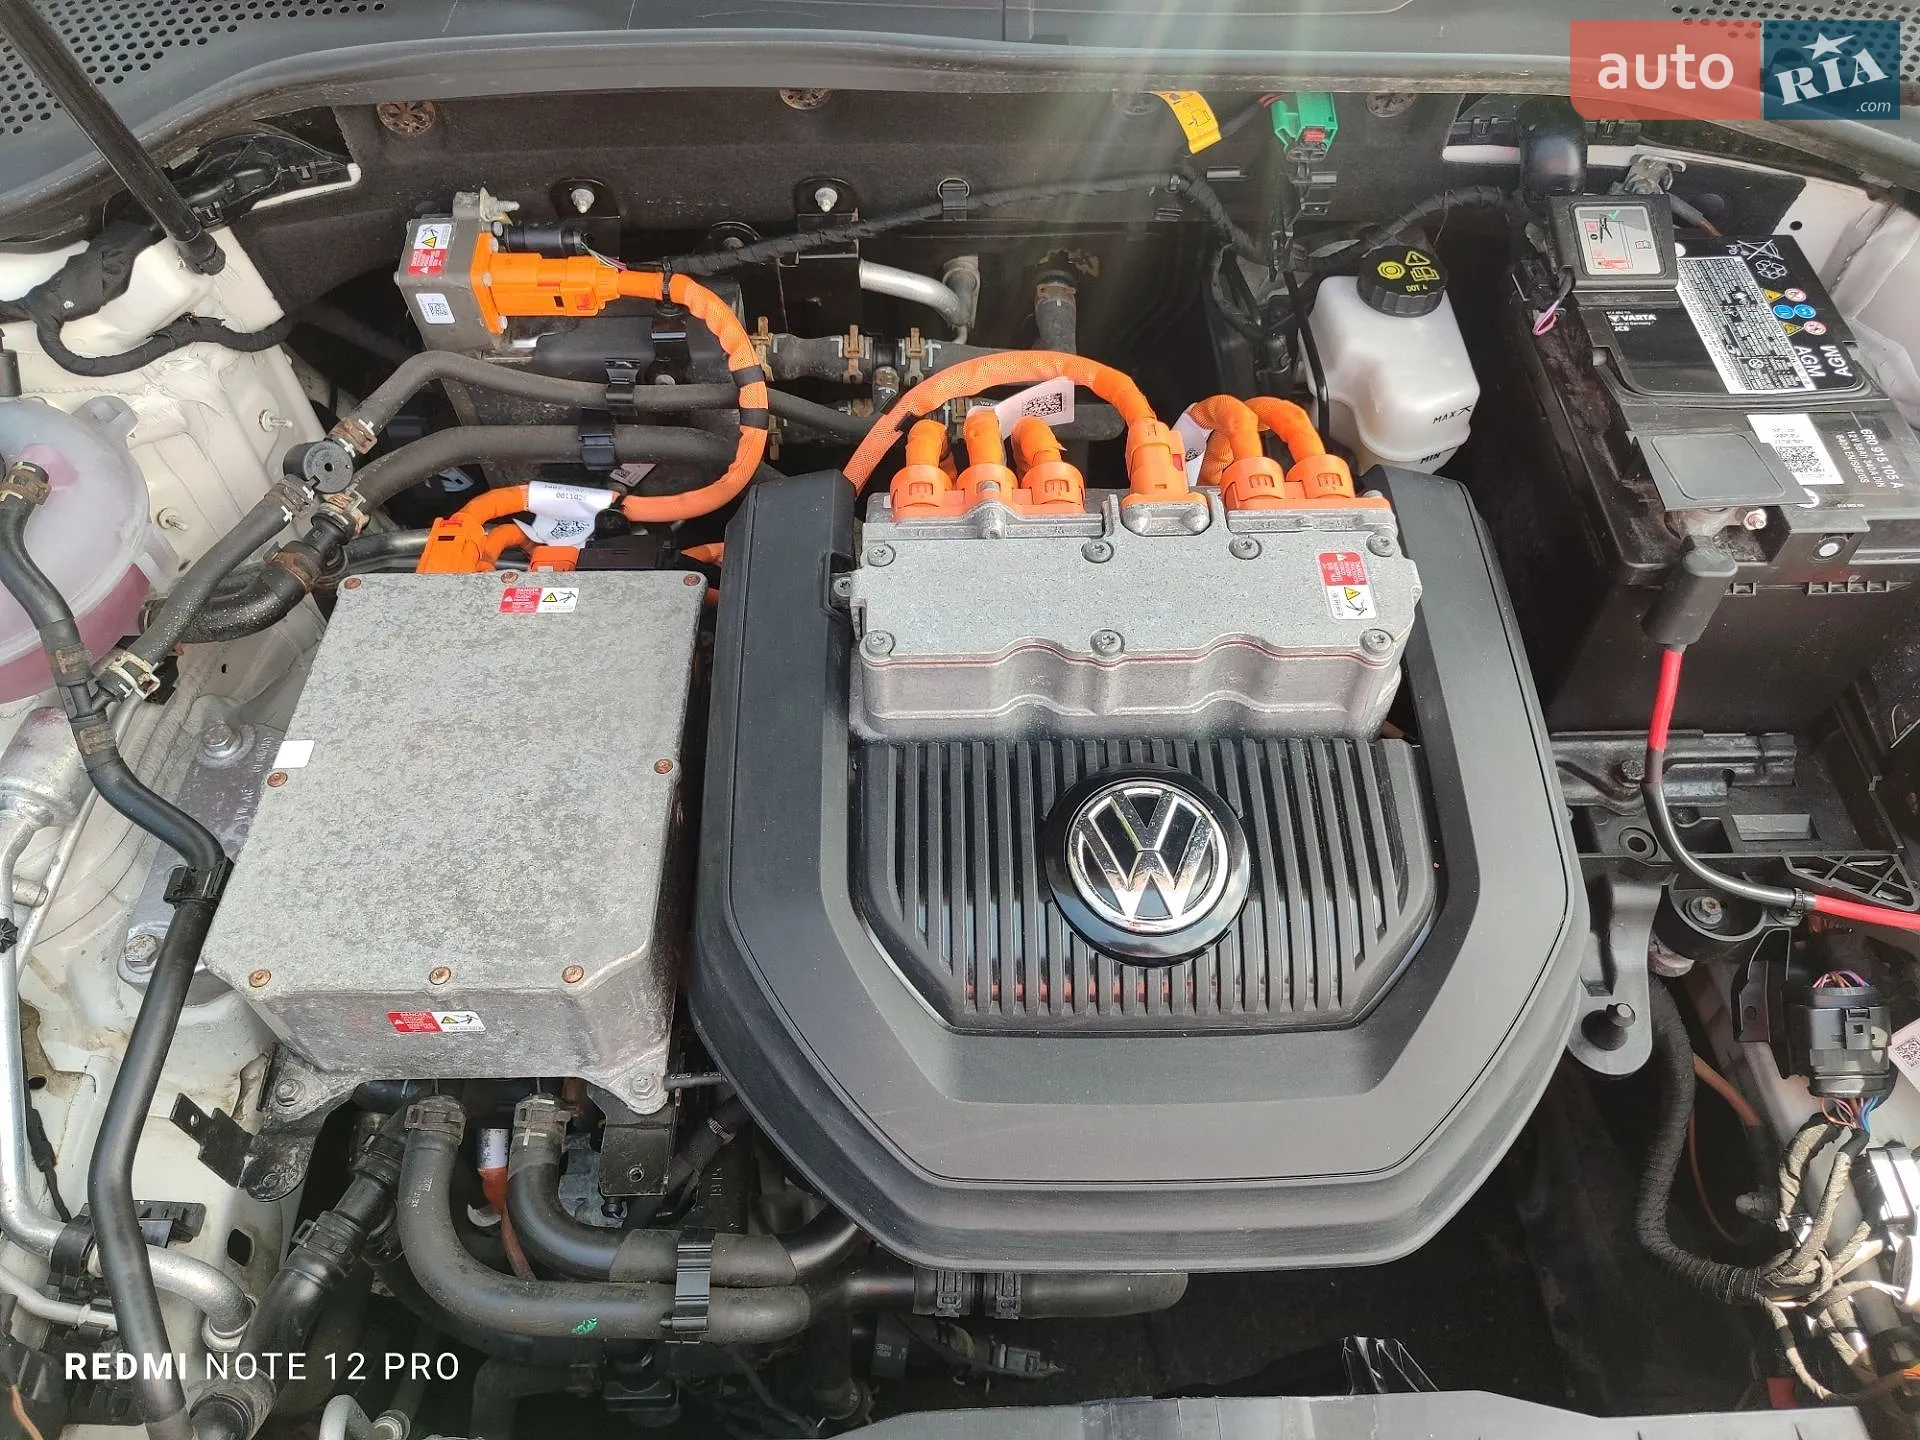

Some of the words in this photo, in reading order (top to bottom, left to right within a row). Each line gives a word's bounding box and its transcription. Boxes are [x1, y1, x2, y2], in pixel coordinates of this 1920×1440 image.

[1620, 313, 1657, 321] VARTA
[1794, 345, 1826, 377] AGM
[1820, 345, 1853, 377] AGM
[1433, 409, 1456, 424] MAX
